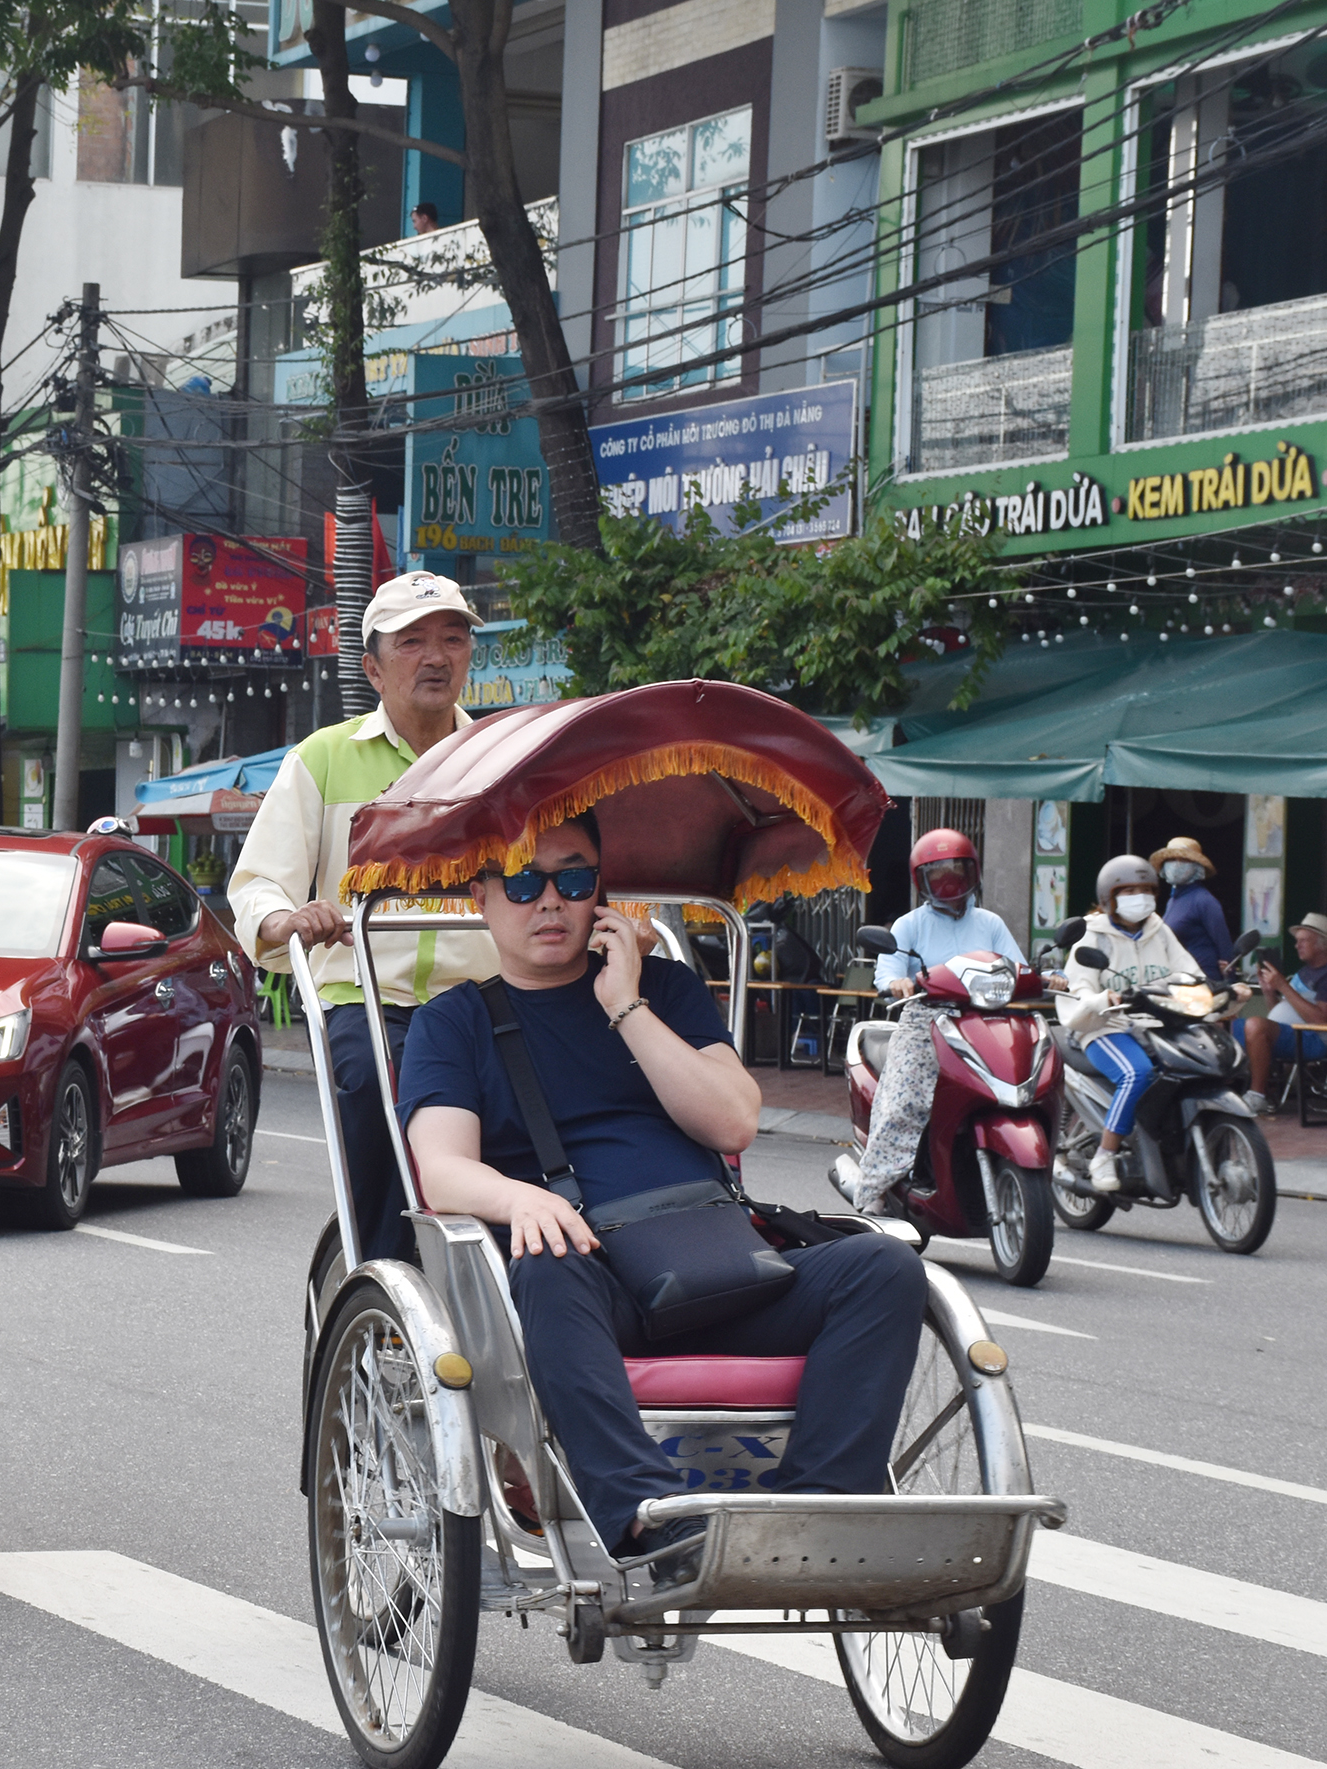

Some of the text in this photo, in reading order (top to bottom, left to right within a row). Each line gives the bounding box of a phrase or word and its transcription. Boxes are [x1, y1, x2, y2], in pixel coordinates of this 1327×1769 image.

[600, 400, 822, 458] CÔNG TY CỔ PHẦN MÔI TRƯỜNG ĐÔ THỊ ĐÀ NẴNG
[422, 436, 543, 528] BẾN TRE
[649, 466, 679, 514] MÔI
[682, 457, 748, 509] TRƯỜNG
[749, 446, 780, 499] HẢI
[782, 443, 830, 494] CHÂU
[996, 481, 1044, 535] TRÁI
[1050, 472, 1104, 531] DỪA
[1127, 473, 1184, 521] KEM
[1188, 452, 1246, 514] TRÁI
[1251, 440, 1314, 505] DỪA
[415, 523, 458, 550] 196
[197, 620, 243, 641] 45k
